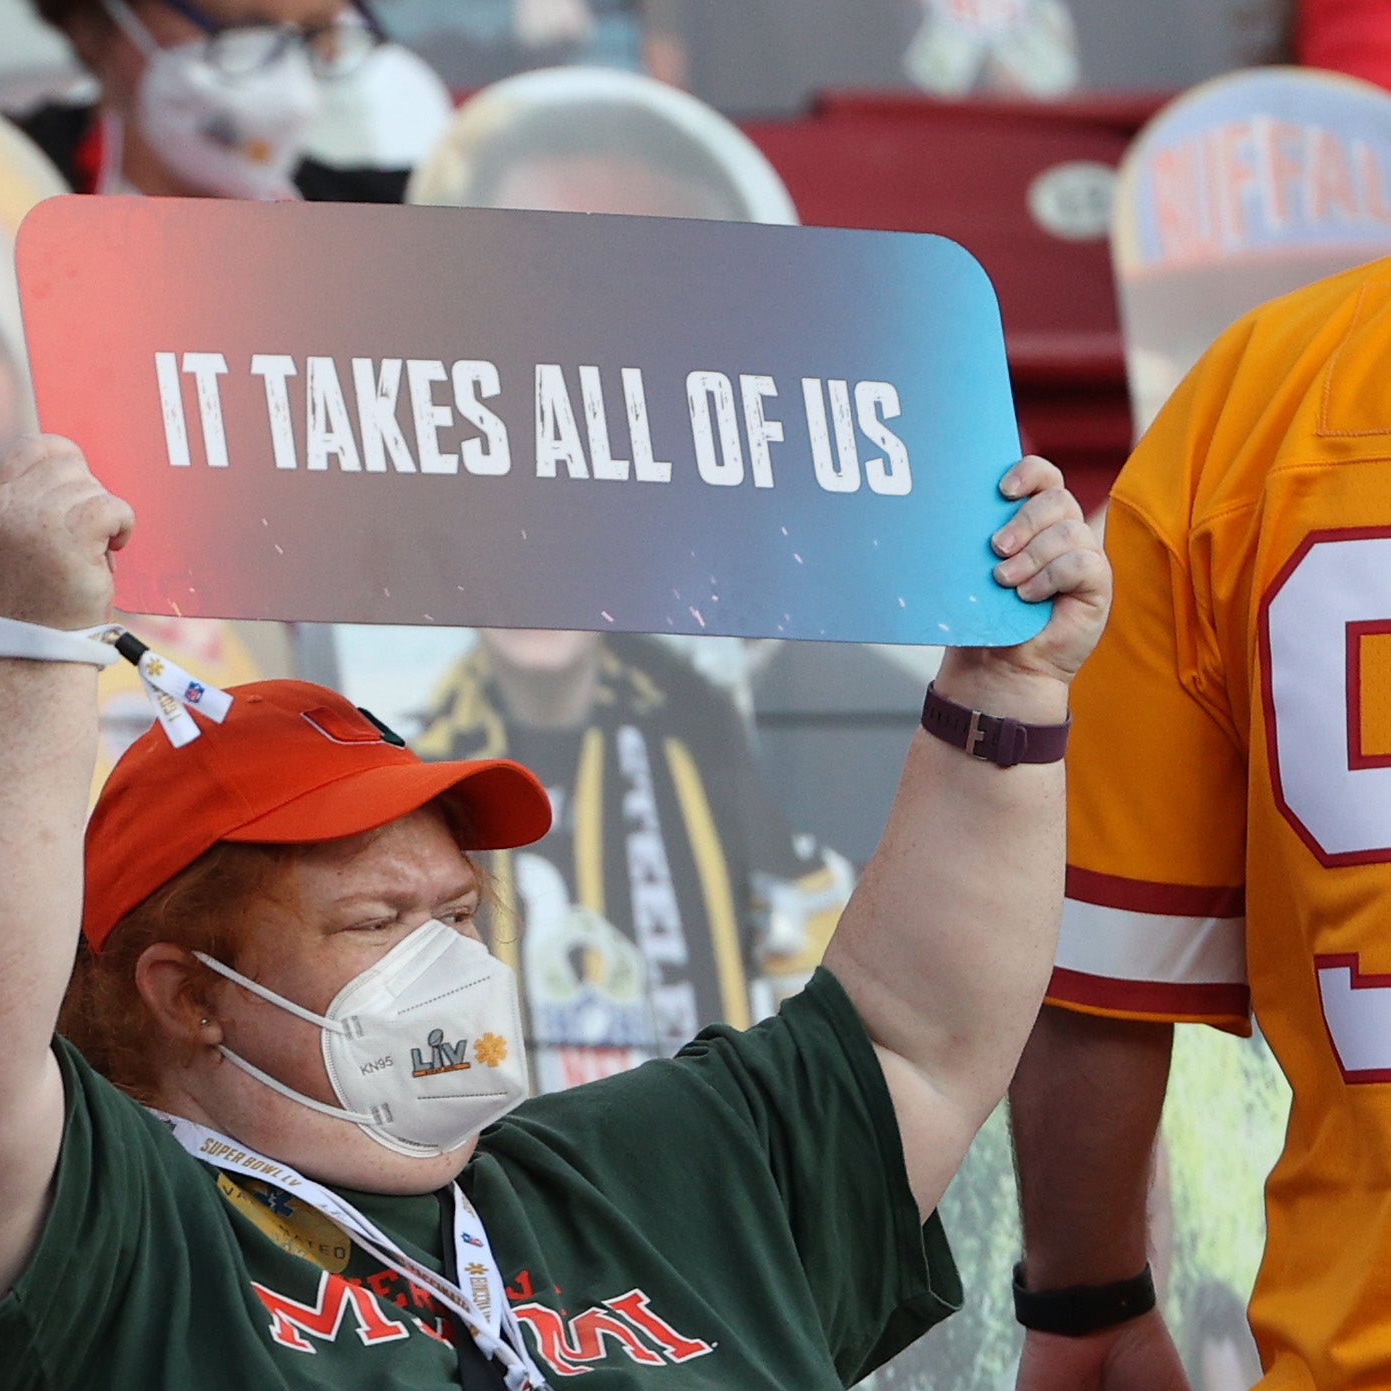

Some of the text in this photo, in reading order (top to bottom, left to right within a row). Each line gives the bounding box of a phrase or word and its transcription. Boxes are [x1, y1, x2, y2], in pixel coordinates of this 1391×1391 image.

[155, 352, 913, 497] IT TAKES ALL OF US
[360, 1055, 394, 1076] KN95
[200, 1137, 303, 1188] SUPER BOWL LV
